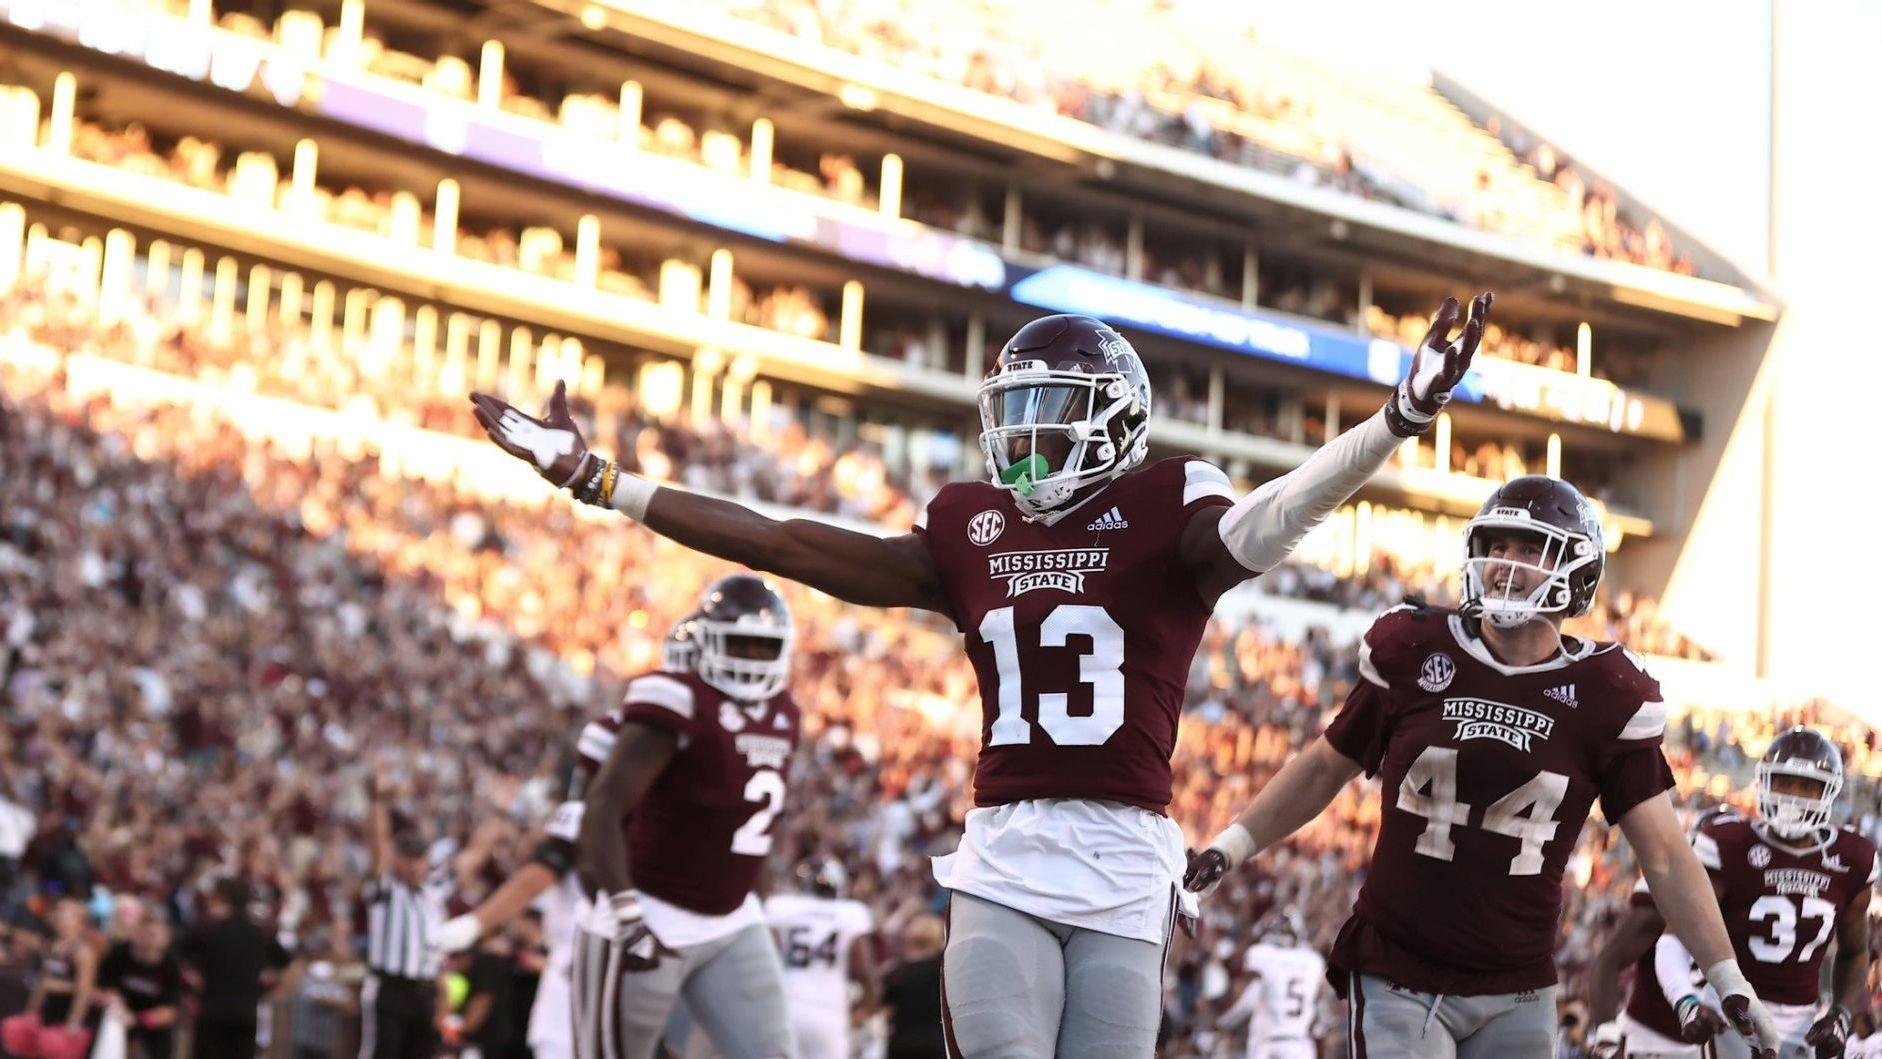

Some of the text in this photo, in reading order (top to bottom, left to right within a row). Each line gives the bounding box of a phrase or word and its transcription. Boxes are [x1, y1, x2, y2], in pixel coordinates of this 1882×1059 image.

[1007, 361, 1034, 372] STATE
[970, 510, 1001, 544] SEC
[1086, 518, 1129, 531] adidas
[988, 551, 1109, 575] MISSISSIPPI
[1018, 574, 1072, 591] STATE
[978, 604, 1125, 747] 13
[1424, 655, 1451, 684] SEC
[1543, 688, 1579, 709] adidas
[1442, 701, 1554, 737] MISSISSIPPI
[1466, 724, 1519, 745] STATE
[730, 770, 786, 856] 2
[1396, 745, 1570, 876] 44
[1748, 895, 1837, 964] 37
[786, 925, 839, 969] 64
[1286, 978, 1305, 1017] 5
